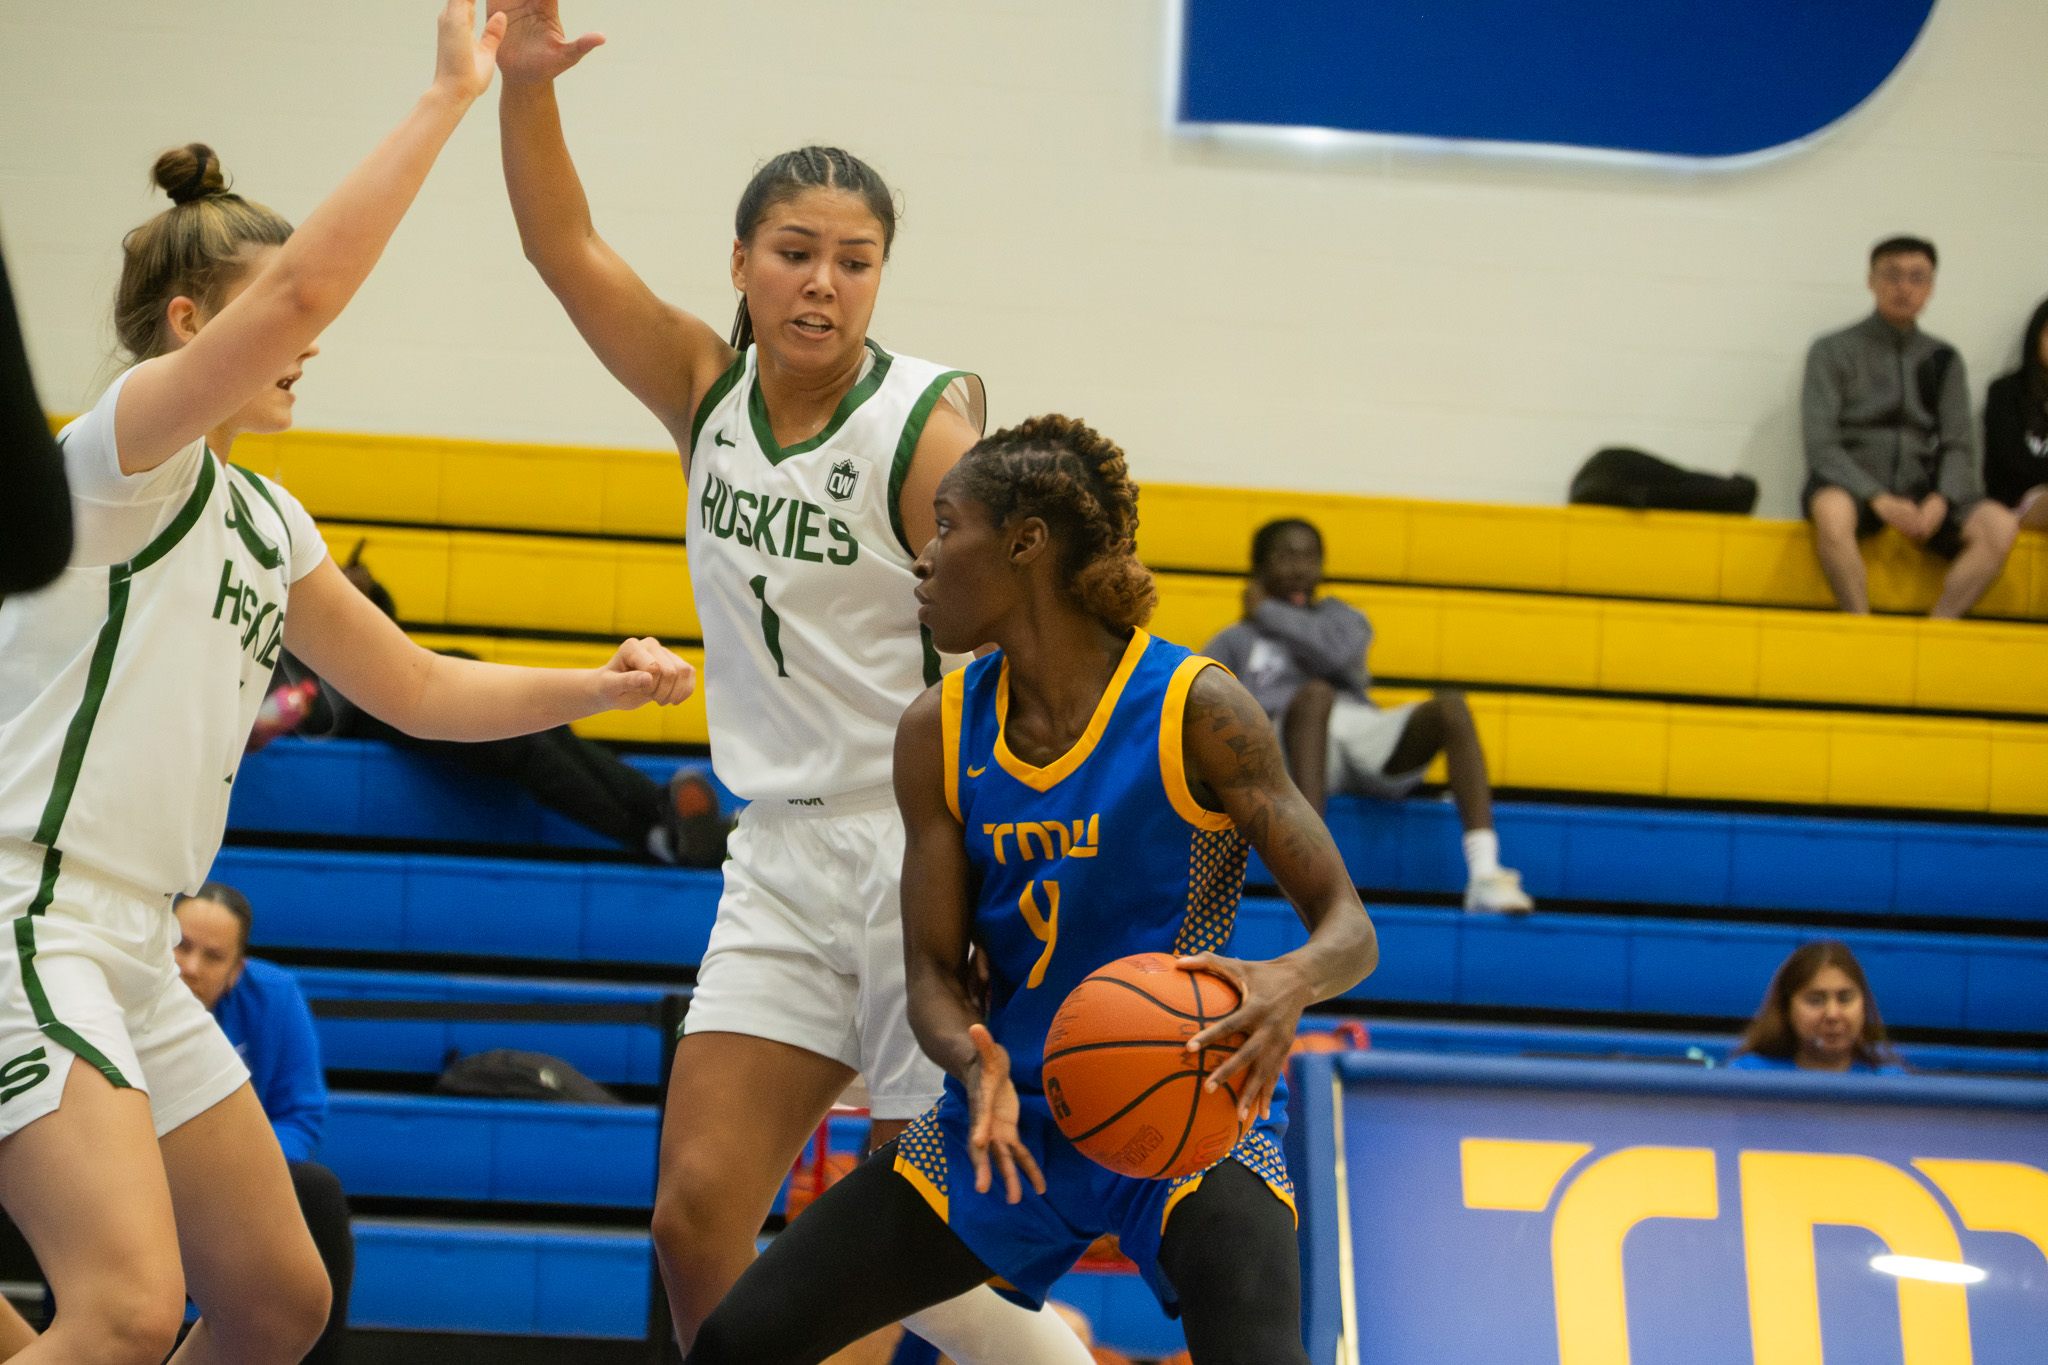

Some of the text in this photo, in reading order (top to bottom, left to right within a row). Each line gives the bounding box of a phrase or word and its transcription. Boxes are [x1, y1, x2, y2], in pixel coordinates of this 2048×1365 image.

[700, 471, 859, 566] HUSKIES
[211, 558, 285, 671] HSKIE
[749, 574, 791, 678] 1
[982, 813, 1100, 865] TMU
